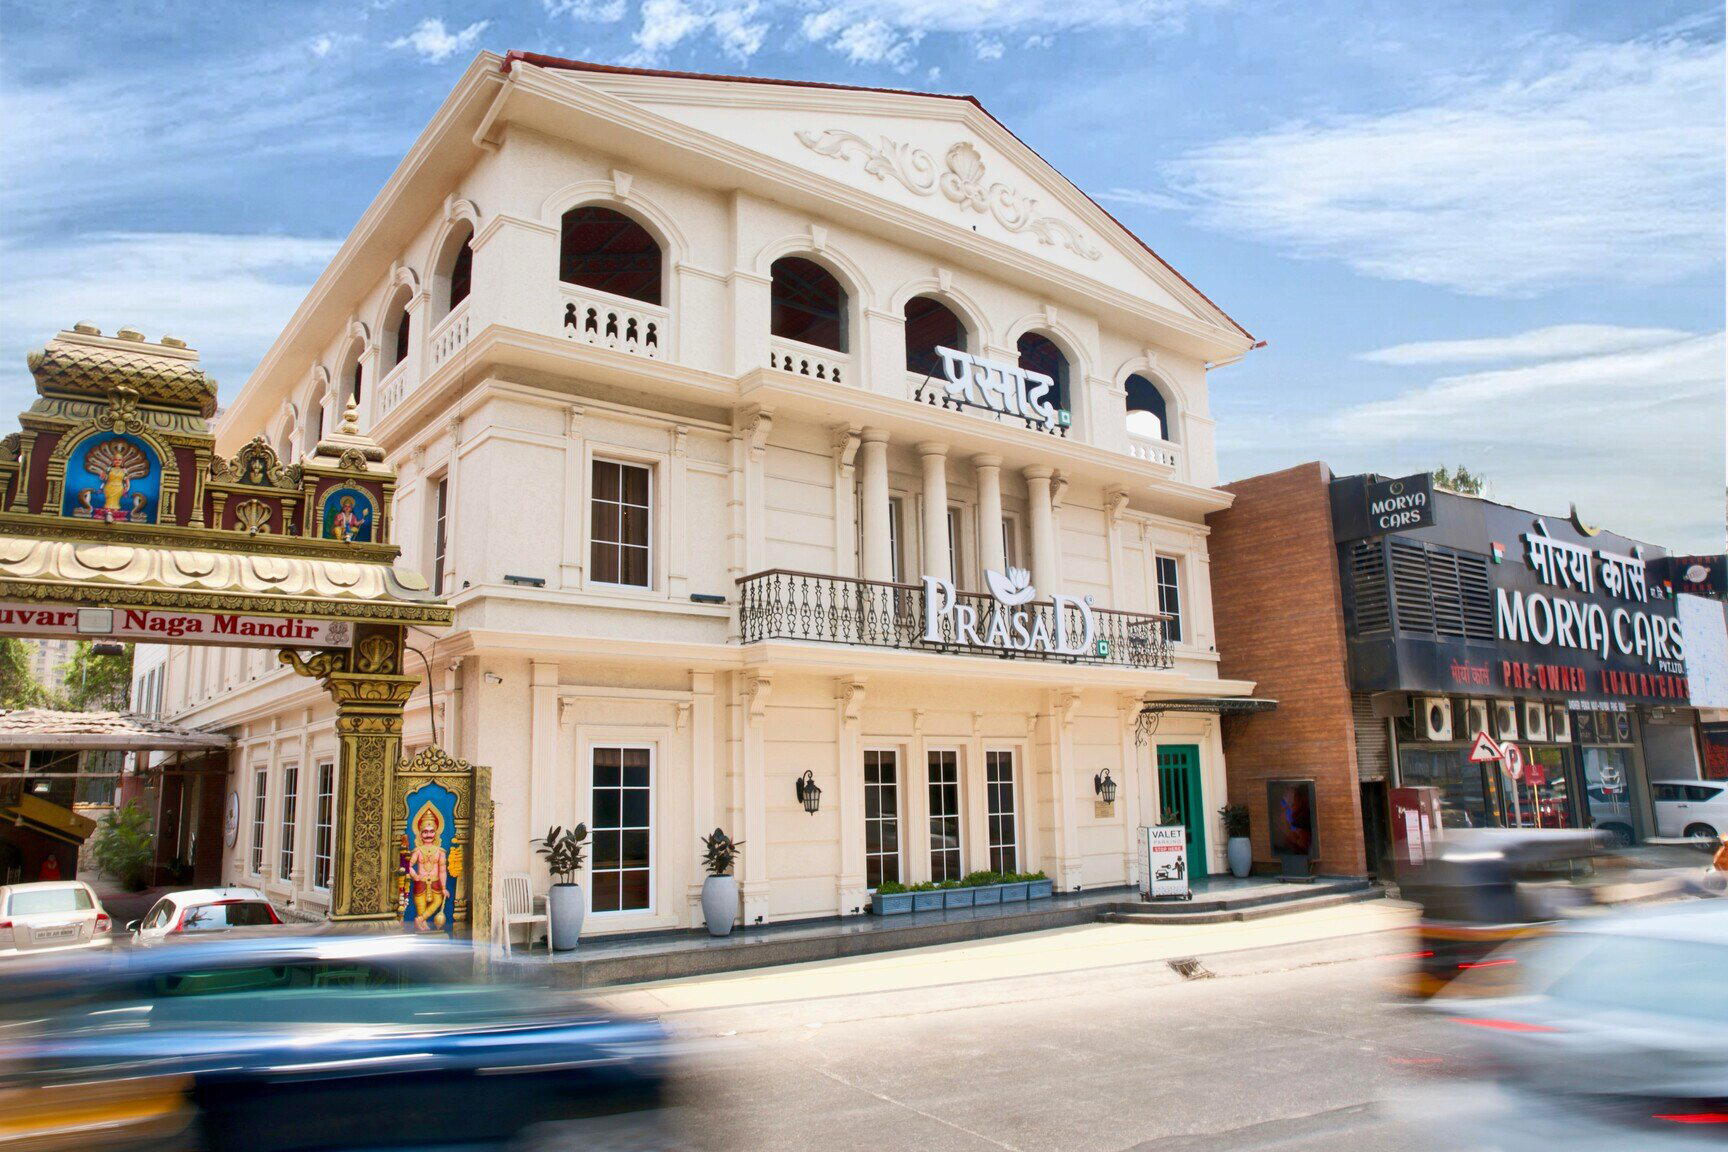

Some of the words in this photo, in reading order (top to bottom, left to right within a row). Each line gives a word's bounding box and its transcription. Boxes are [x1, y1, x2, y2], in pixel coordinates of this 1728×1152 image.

[935, 345, 1055, 430] प्रसाद
[1371, 492, 1426, 515] MORYA
[1379, 509, 1421, 529] CARS
[1525, 517, 1595, 594] मोरया
[1599, 545, 1648, 603] कार्स
[122, 609, 203, 637] Naga
[211, 614, 319, 640] Mandir
[1497, 587, 1609, 661] MORYA
[1613, 608, 1685, 665] CARS
[1502, 660, 1587, 692] PRE-OWNED
[1152, 830, 1182, 839] VALET
